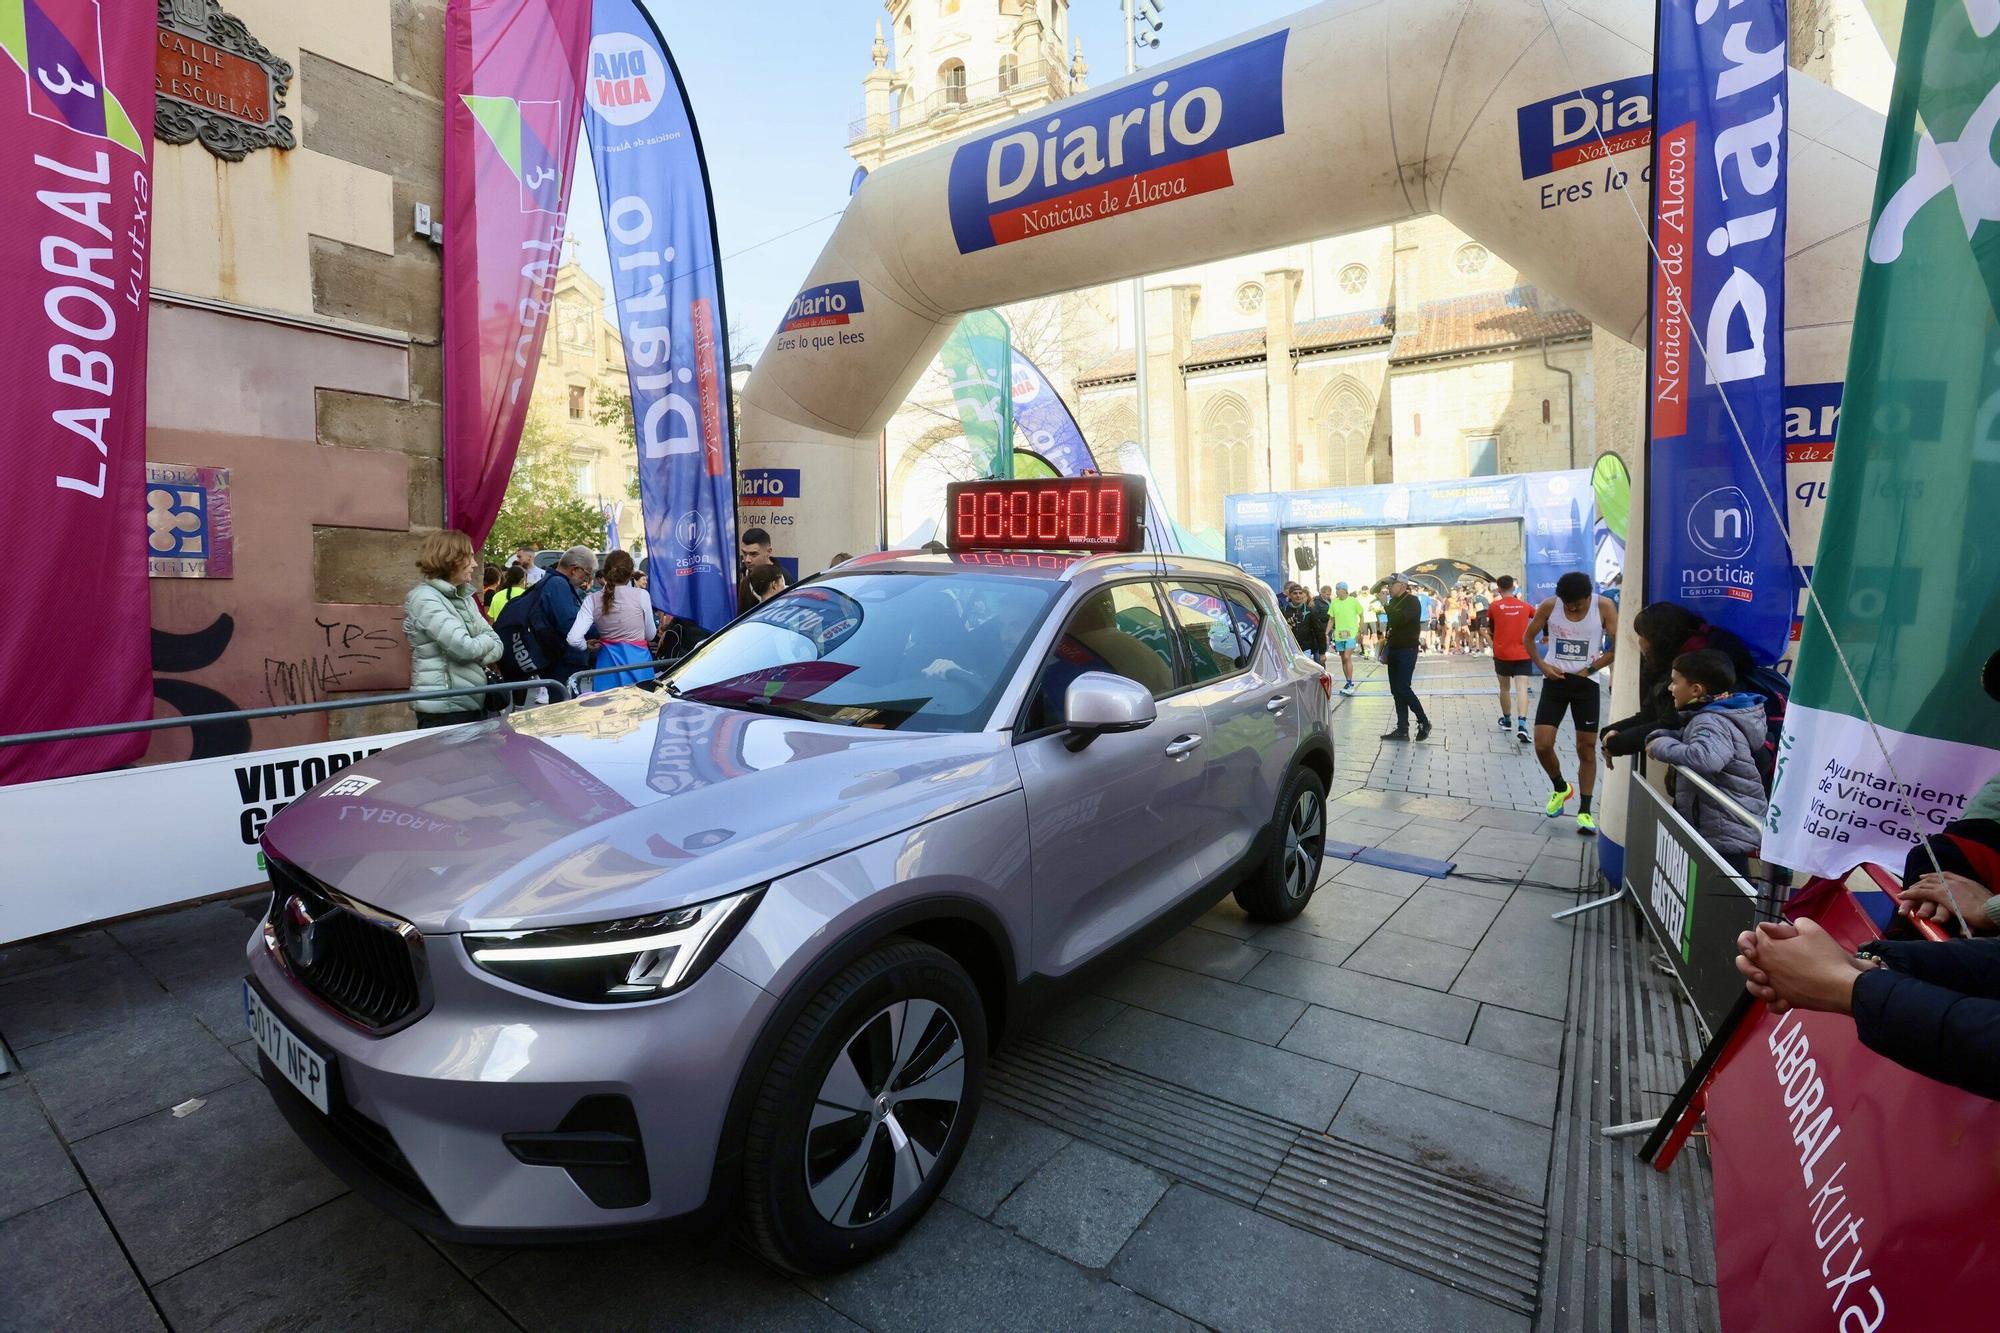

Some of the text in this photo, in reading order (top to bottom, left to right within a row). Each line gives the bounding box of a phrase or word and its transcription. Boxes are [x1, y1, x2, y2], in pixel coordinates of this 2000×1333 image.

[159, 32, 225, 69] CALLE
[182, 60, 205, 82] DE
[172, 78, 265, 122] ESCUELAS
[986, 80, 1223, 204] Diario
[1576, 137, 1636, 163] Noticias
[1022, 175, 1187, 234] Noticias de Álava
[1541, 180, 1593, 210] Eres
[1604, 167, 1628, 193] lo
[126, 170, 149, 311] kutxa
[1657, 137, 1686, 404] Noticias de Álava
[788, 287, 847, 320] Diario
[34, 151, 117, 498] LABORAL
[777, 330, 865, 351] Eres lo que lees
[1799, 446, 1820, 461] de
[750, 514, 771, 527] que
[770, 511, 795, 525] lees
[958, 489, 1121, 538] 00:00:00
[1714, 507, 1742, 538] n
[1682, 563, 1754, 585] noticias
[1689, 588, 1720, 596] GRUPO
[1562, 644, 1581, 654] 983
[1818, 776, 1832, 794] de
[1803, 815, 1850, 843] Udala
[1656, 819, 1689, 902] VITORIA
[1651, 865, 1686, 954] GASTEIZ
[287, 1036, 320, 1096] NFP
[1768, 1008, 1885, 1333] LABORAL kutxa
